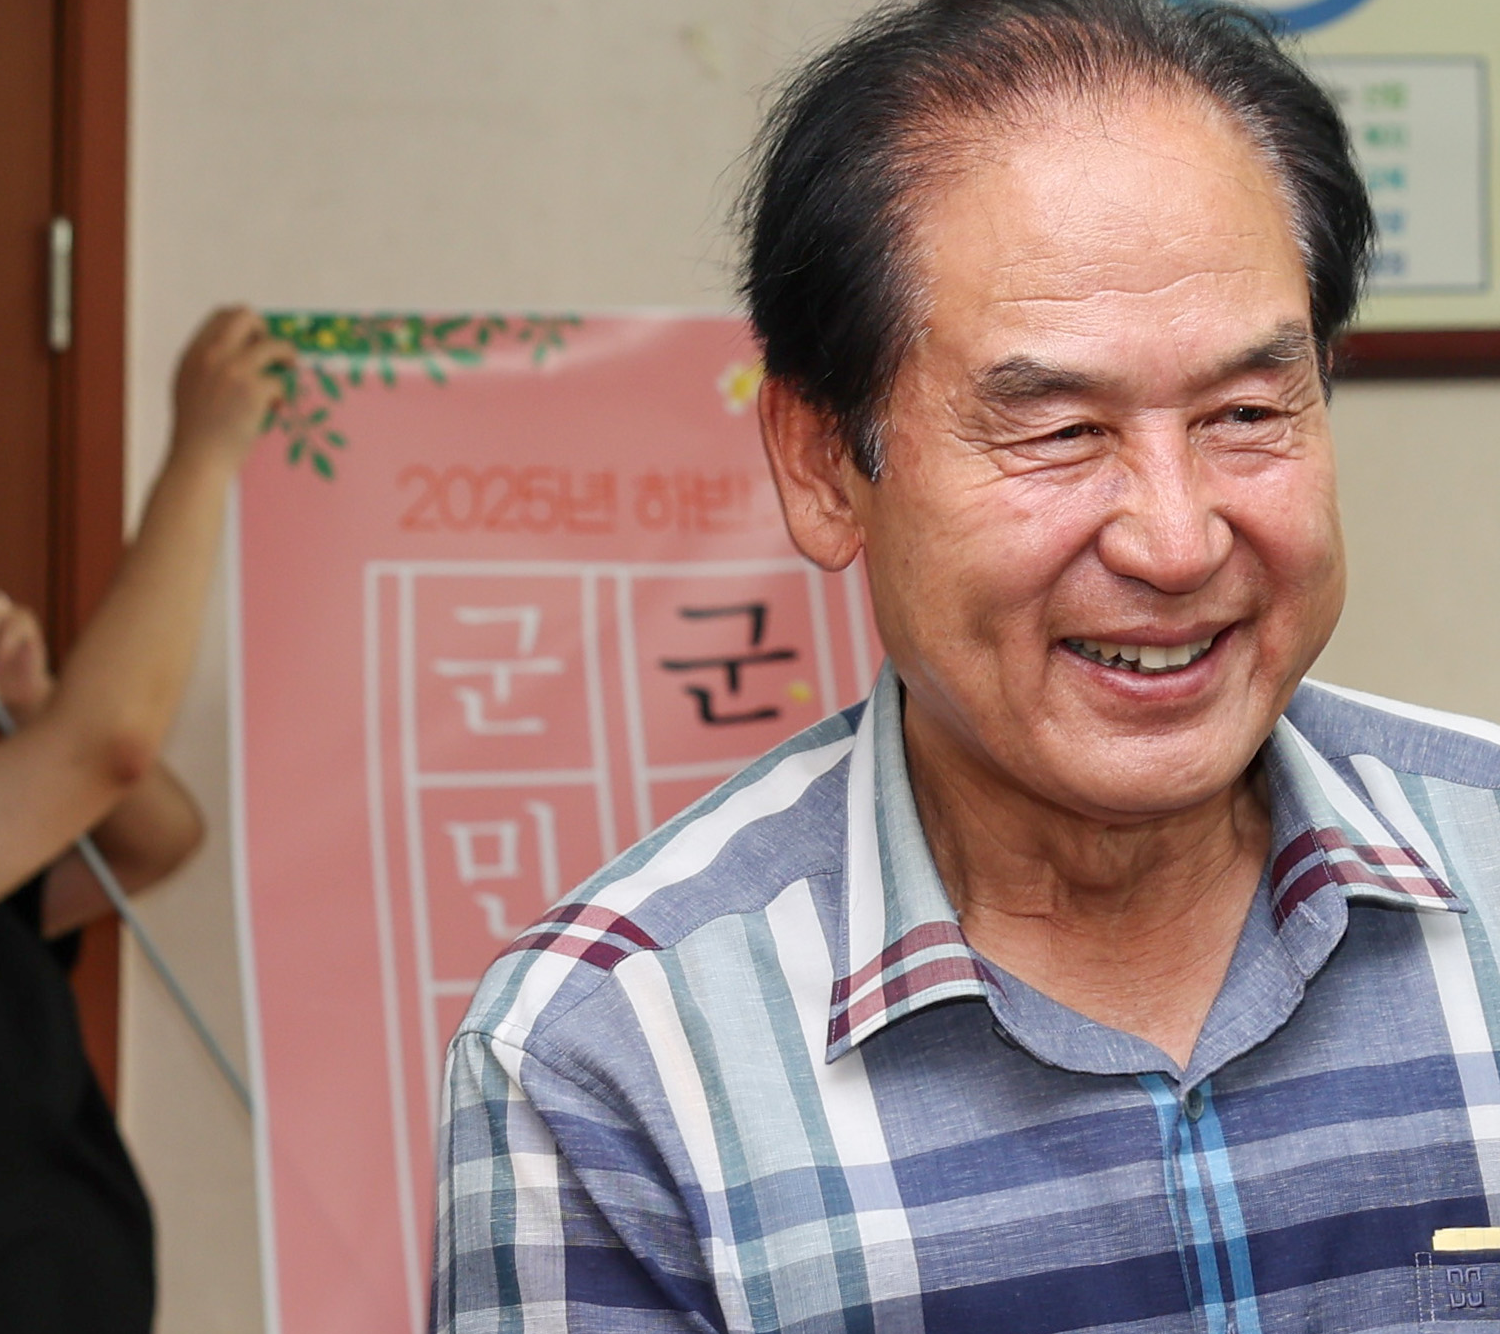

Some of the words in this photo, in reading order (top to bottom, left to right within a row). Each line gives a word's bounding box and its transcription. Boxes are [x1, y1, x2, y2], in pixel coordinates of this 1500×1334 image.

[396, 464, 618, 536] 2025년
[634, 466, 756, 536] 하반
[659, 600, 800, 729] 군
